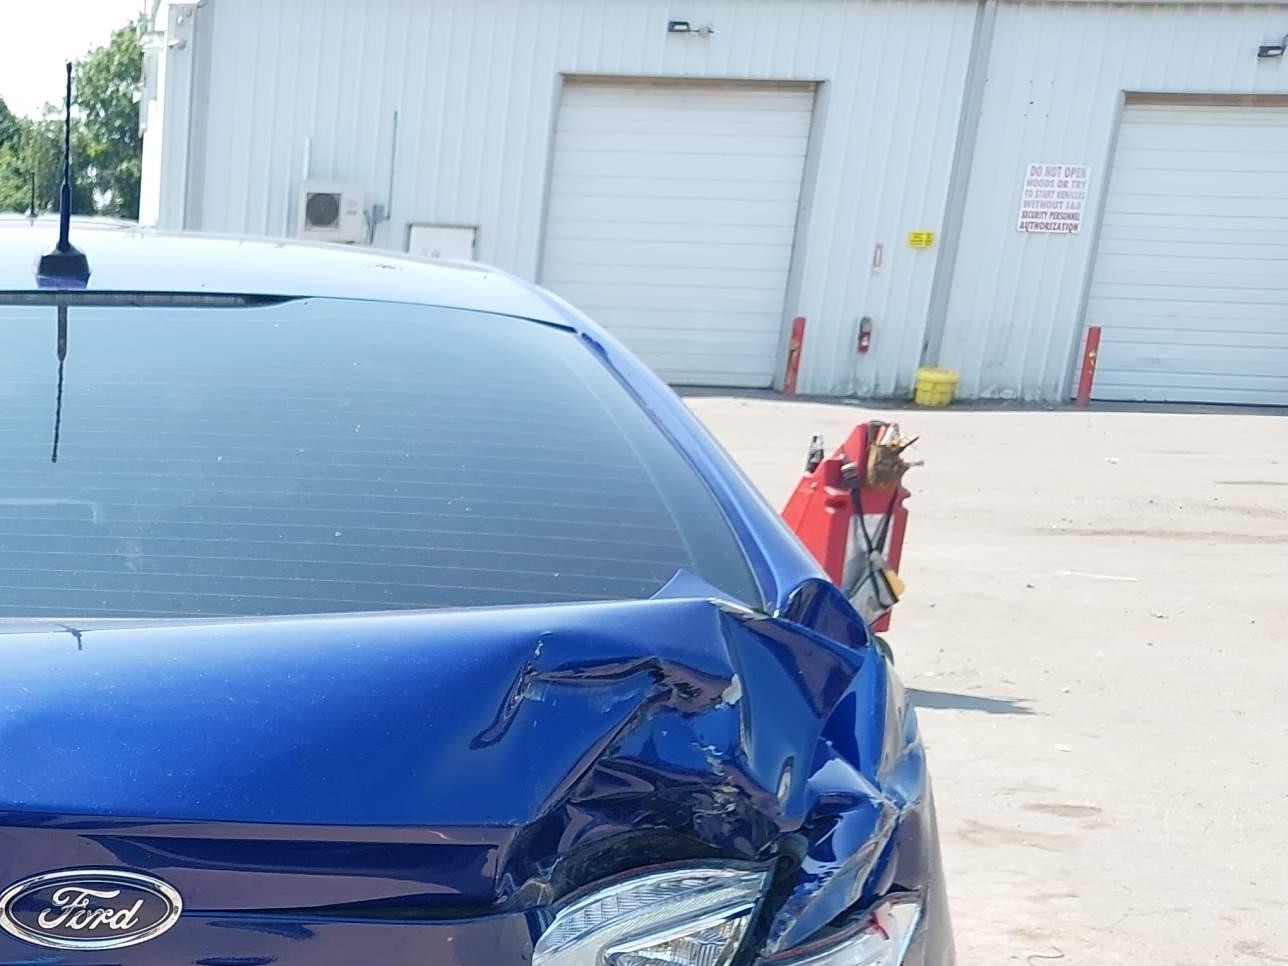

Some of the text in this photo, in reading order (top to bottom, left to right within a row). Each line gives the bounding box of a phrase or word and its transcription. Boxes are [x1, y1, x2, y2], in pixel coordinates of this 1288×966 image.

[1030, 165, 1087, 178] DO NOT OPEN
[1026, 179, 1087, 189] HOODS OR TRY
[1023, 200, 1064, 209] WITHOUT
[1021, 210, 1048, 220] SECURITY
[1019, 221, 1079, 232] AUTHORIZATION
[37, 886, 144, 930] Ford
